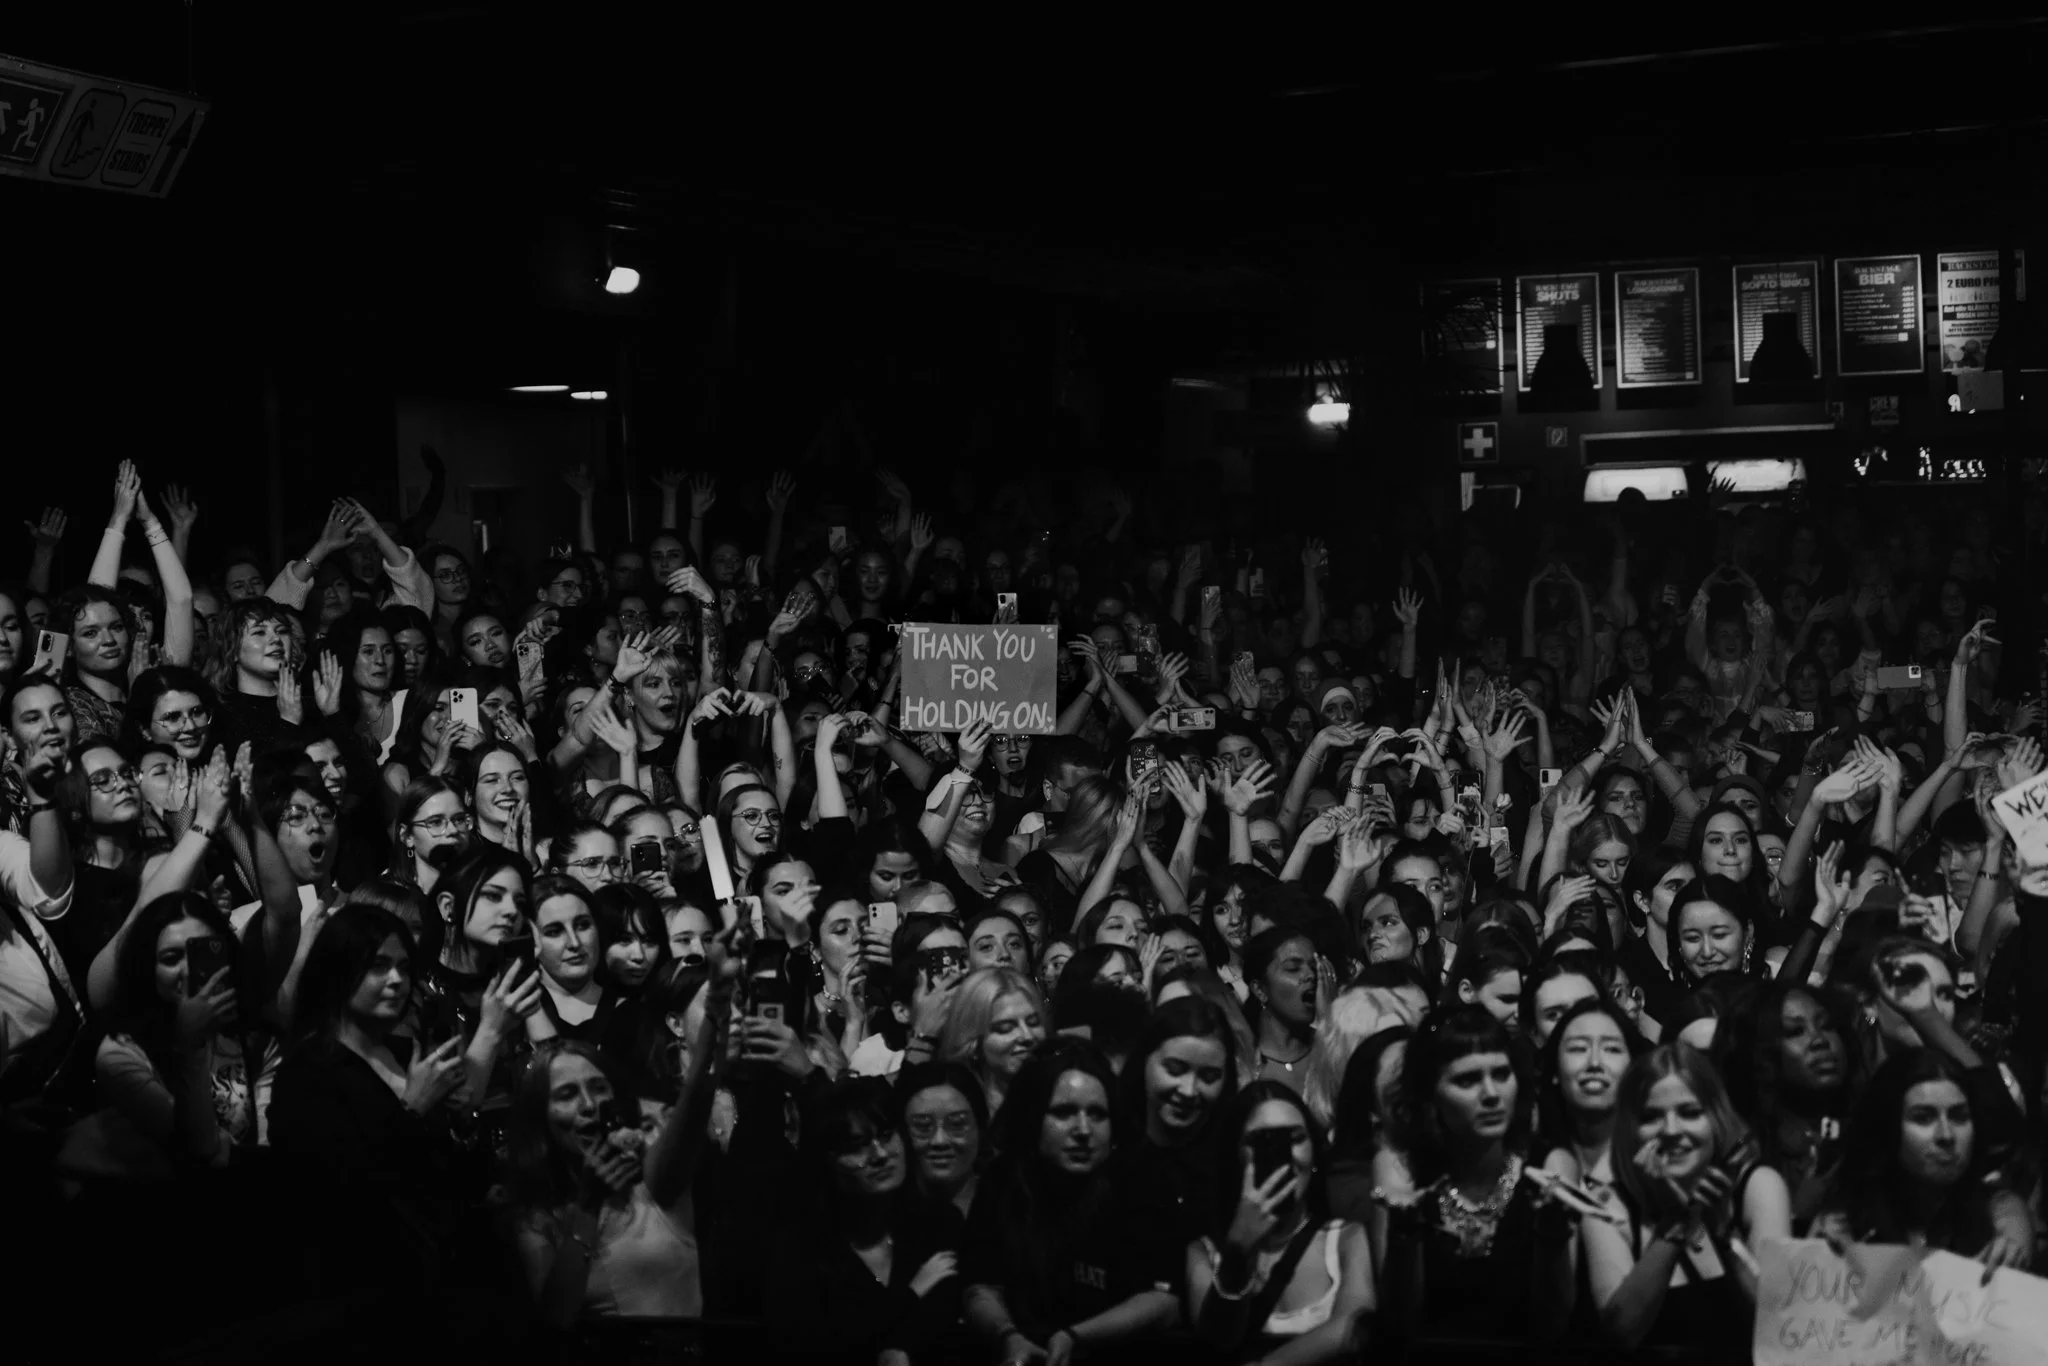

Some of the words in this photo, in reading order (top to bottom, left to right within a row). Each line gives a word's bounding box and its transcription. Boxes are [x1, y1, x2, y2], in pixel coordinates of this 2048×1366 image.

[127, 111, 169, 137] TREPPE
[108, 148, 150, 173] STAIRS
[1859, 272, 1896, 286] BIER
[1947, 279, 1954, 288] 2
[1955, 277, 1981, 288] EURO
[1536, 290, 1580, 302] SHOTS
[906, 627, 985, 661] THANK
[993, 628, 1036, 663] YOU
[951, 664, 999, 691] FOR
[904, 695, 1012, 730] HOLDING
[1781, 1260, 1866, 1309] YOUR
[1779, 1317, 1853, 1353] GAVE
[1867, 1320, 1918, 1352] ME
